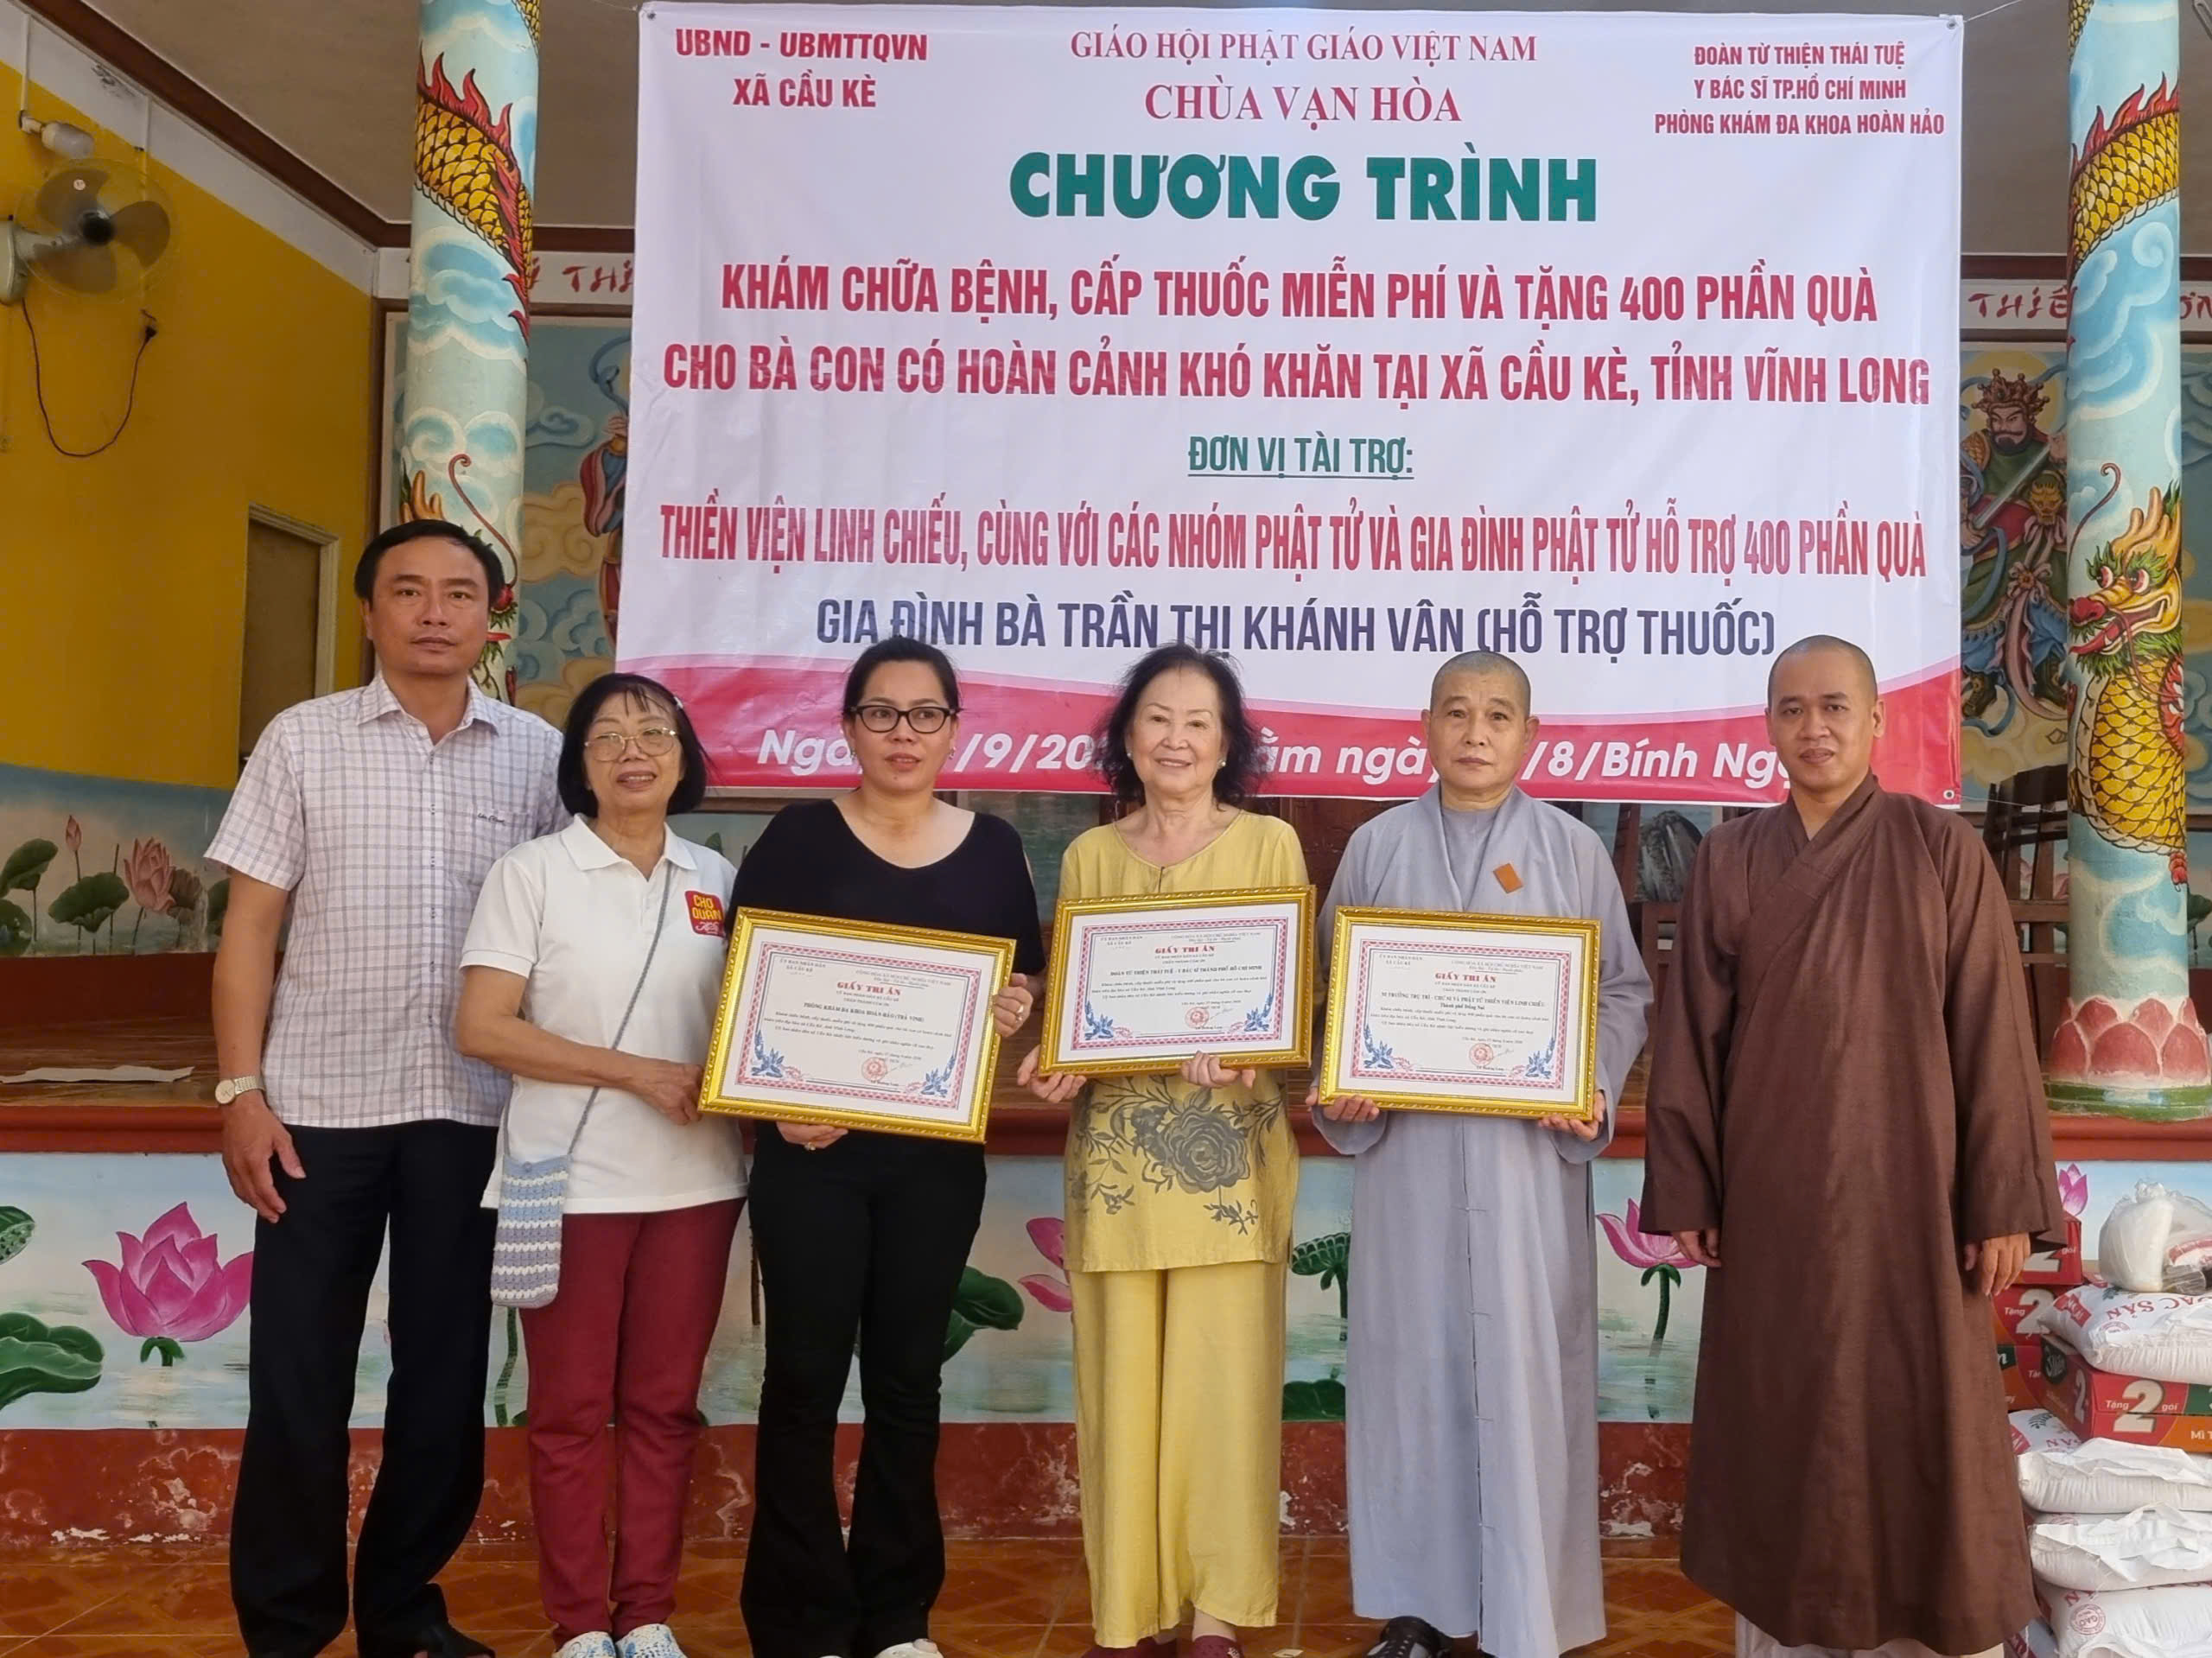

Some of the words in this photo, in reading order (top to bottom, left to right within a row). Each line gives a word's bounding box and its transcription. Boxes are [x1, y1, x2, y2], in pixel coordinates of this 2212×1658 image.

[676, 29, 751, 56] UBND
[780, 32, 927, 63] UBMTTQVN
[1071, 23, 1147, 58] GIÁO
[1156, 29, 1210, 66] HỘI
[1219, 29, 1299, 66] PHẬT
[1307, 26, 1382, 60] GIÁO
[1391, 30, 1460, 67] VIỆT
[1469, 35, 1536, 60] NAM
[1694, 42, 1742, 65] ĐOÀN
[1747, 42, 1770, 65] TỪ
[1774, 42, 1824, 68] THIỆN
[1829, 41, 1868, 64] THÁI
[1873, 41, 1904, 69] TUỆ
[733, 73, 770, 106] XÃ
[779, 69, 833, 107] CẦU
[842, 73, 875, 107] KÈ
[1146, 74, 1263, 120] CHÙA
[1272, 86, 1359, 130] VẠN
[1370, 76, 1462, 122] HÒA
[1694, 79, 1705, 98] Y
[1710, 75, 1745, 99] BÁC
[1750, 75, 1769, 99] SĨ
[1773, 73, 1819, 99] TP.HỒ
[1825, 76, 1853, 99] CHÍ
[1859, 79, 1906, 100] MINH
[1656, 109, 1713, 134] PHÒNG
[1719, 110, 1770, 134] KHÁM
[1776, 115, 1800, 134] ĐA
[1805, 115, 1852, 135] KHOA
[1857, 110, 1904, 133] HOÀN
[1910, 108, 1943, 134] HẢO
[1010, 152, 1340, 221] CHƯƠNG
[1366, 142, 1596, 221] TRÌNH
[722, 255, 829, 310] KHÁM
[842, 258, 939, 313] CHỮA
[951, 259, 1058, 324] BỆNH,
[1071, 254, 1141, 315] CẤP
[1154, 255, 1269, 317] THUỐC
[1282, 256, 1374, 318] MIỄN
[1388, 264, 1446, 318] PHÍ
[1458, 264, 1503, 319] VÀ
[1515, 265, 1607, 330] TẶNG
[1620, 276, 1684, 321] 400
[1697, 259, 1794, 320] PHẦN
[1808, 267, 1878, 327] QUÀ
[664, 344, 736, 390] CHO
[749, 335, 797, 390] BÀ
[810, 346, 885, 392] CON
[897, 339, 944, 393] CÓ
[957, 340, 1056, 395] HOÀN
[1069, 335, 1166, 397] CẢNH
[1179, 342, 1250, 397] KHÓ
[1263, 344, 1361, 398] KHĂN
[1373, 354, 1427, 410] TẠI
[1440, 346, 1488, 400] XÃ
[1500, 340, 1571, 401] CẦU
[1584, 346, 1638, 406] KÈ,
[1650, 340, 1732, 400] TỈNH
[1744, 346, 1826, 403] VĨNH
[1839, 358, 1929, 404] LONG
[1188, 435, 1249, 471] ĐƠN
[1257, 437, 1285, 479] VỊ
[1294, 430, 1340, 473] TÀI
[1349, 437, 1413, 480] TRỢ:
[660, 488, 738, 560] THIỀN
[747, 495, 805, 574] VIỆN
[814, 508, 874, 562] LINH
[883, 492, 968, 572] CHIẾU,
[977, 499, 1049, 566] CÙNG
[1058, 500, 1099, 567] VỚI
[1108, 501, 1160, 568] CÁC
[1168, 502, 1246, 569] NHÓM
[1255, 504, 1322, 582] PHẬT
[1330, 497, 1363, 570] TỬ
[1369, 505, 1402, 570] VÀ
[1411, 516, 1453, 571] GIA
[1461, 505, 1523, 571] ĐÌNH
[1533, 505, 1599, 585] PHẬT
[1606, 499, 1640, 573] TỬ
[1646, 498, 1679, 574] HỖ
[1688, 514, 1736, 587] TRỢ
[1744, 520, 1790, 575] 400
[1799, 500, 1868, 575] PHẦN
[1877, 511, 1926, 582] QUÀ
[817, 599, 879, 644] GIA
[891, 592, 983, 645] ĐÌNH
[995, 594, 1046, 647] BÀ
[1058, 590, 1159, 648] TRẦN
[1170, 605, 1231, 657] THỊ
[1244, 598, 1375, 651] KHÁNH
[1388, 599, 1464, 652] VÂN
[1478, 592, 1542, 653] (HỖ
[1554, 607, 1628, 664] TRỢ
[1637, 598, 1775, 656] THUỐC)
[1336, 736, 1439, 785] ngà
[2113, 1380, 2164, 1433] 2
